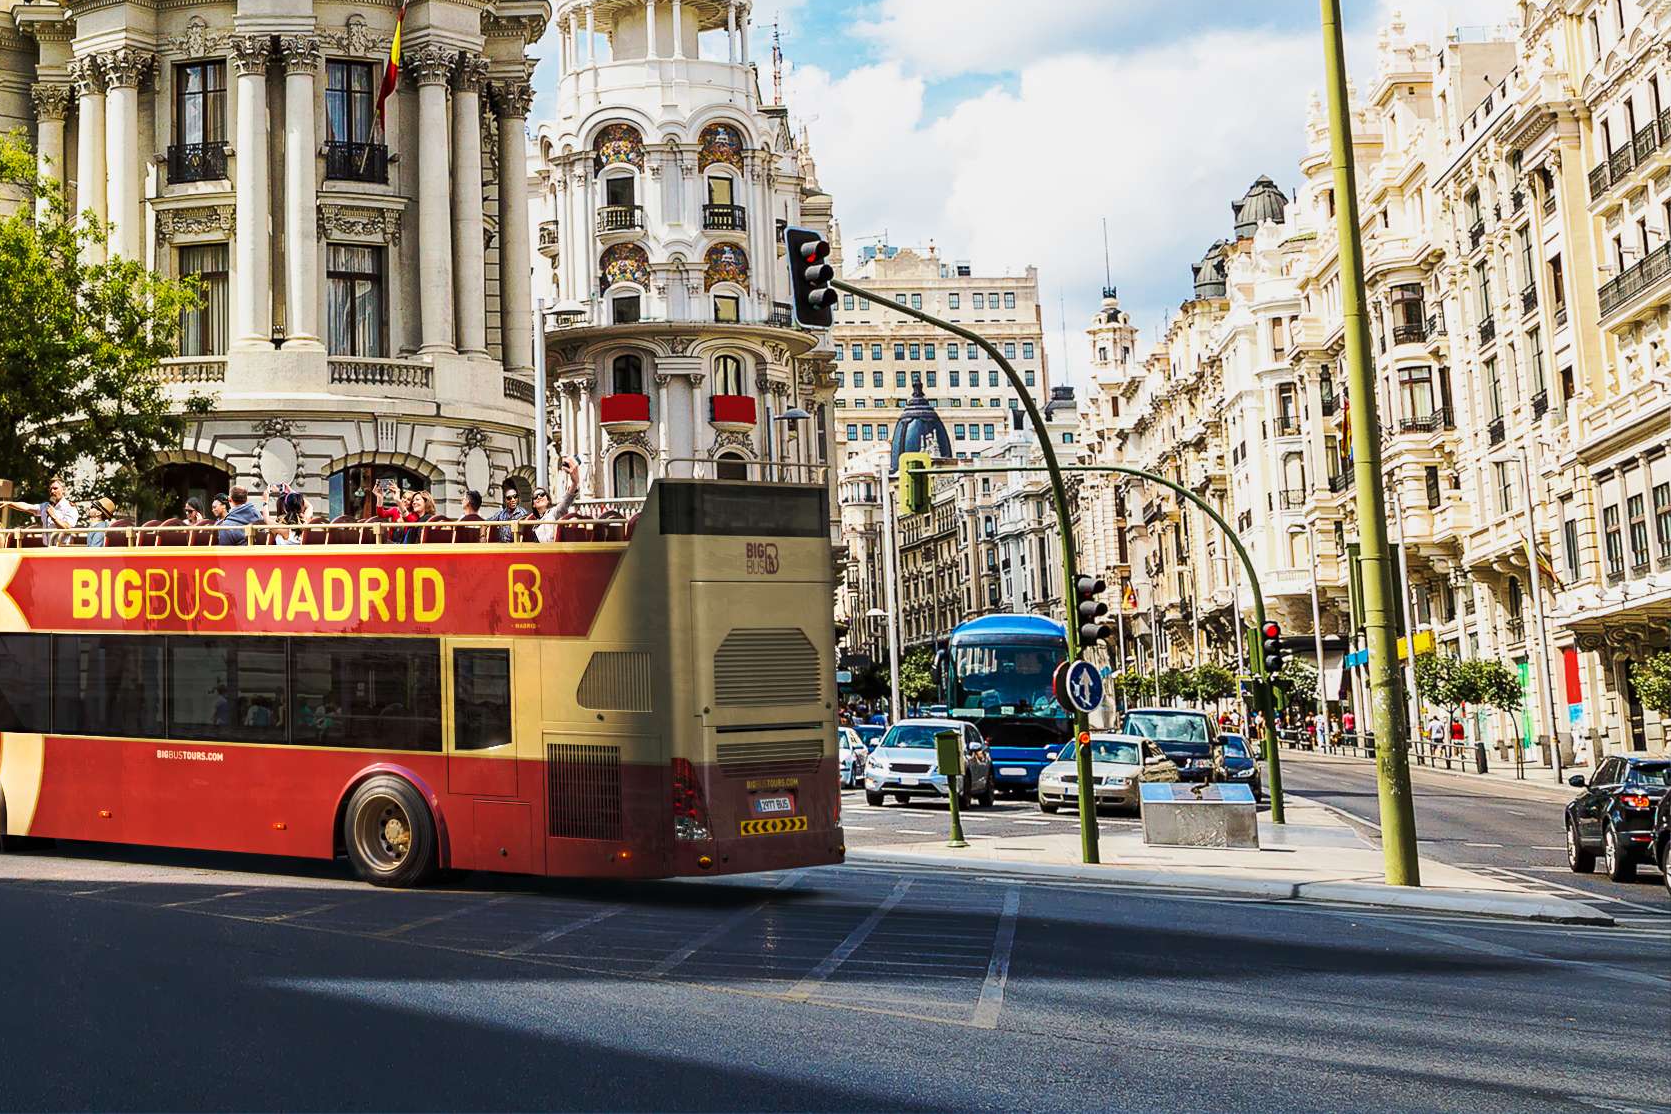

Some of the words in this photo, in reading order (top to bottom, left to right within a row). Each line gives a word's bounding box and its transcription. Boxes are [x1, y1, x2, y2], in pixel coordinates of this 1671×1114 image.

[746, 542, 765, 558] BIG
[746, 559, 766, 574] BUS
[245, 567, 446, 623] MADRID
[156, 749, 224, 762] BIGBUSTOURS.COM
